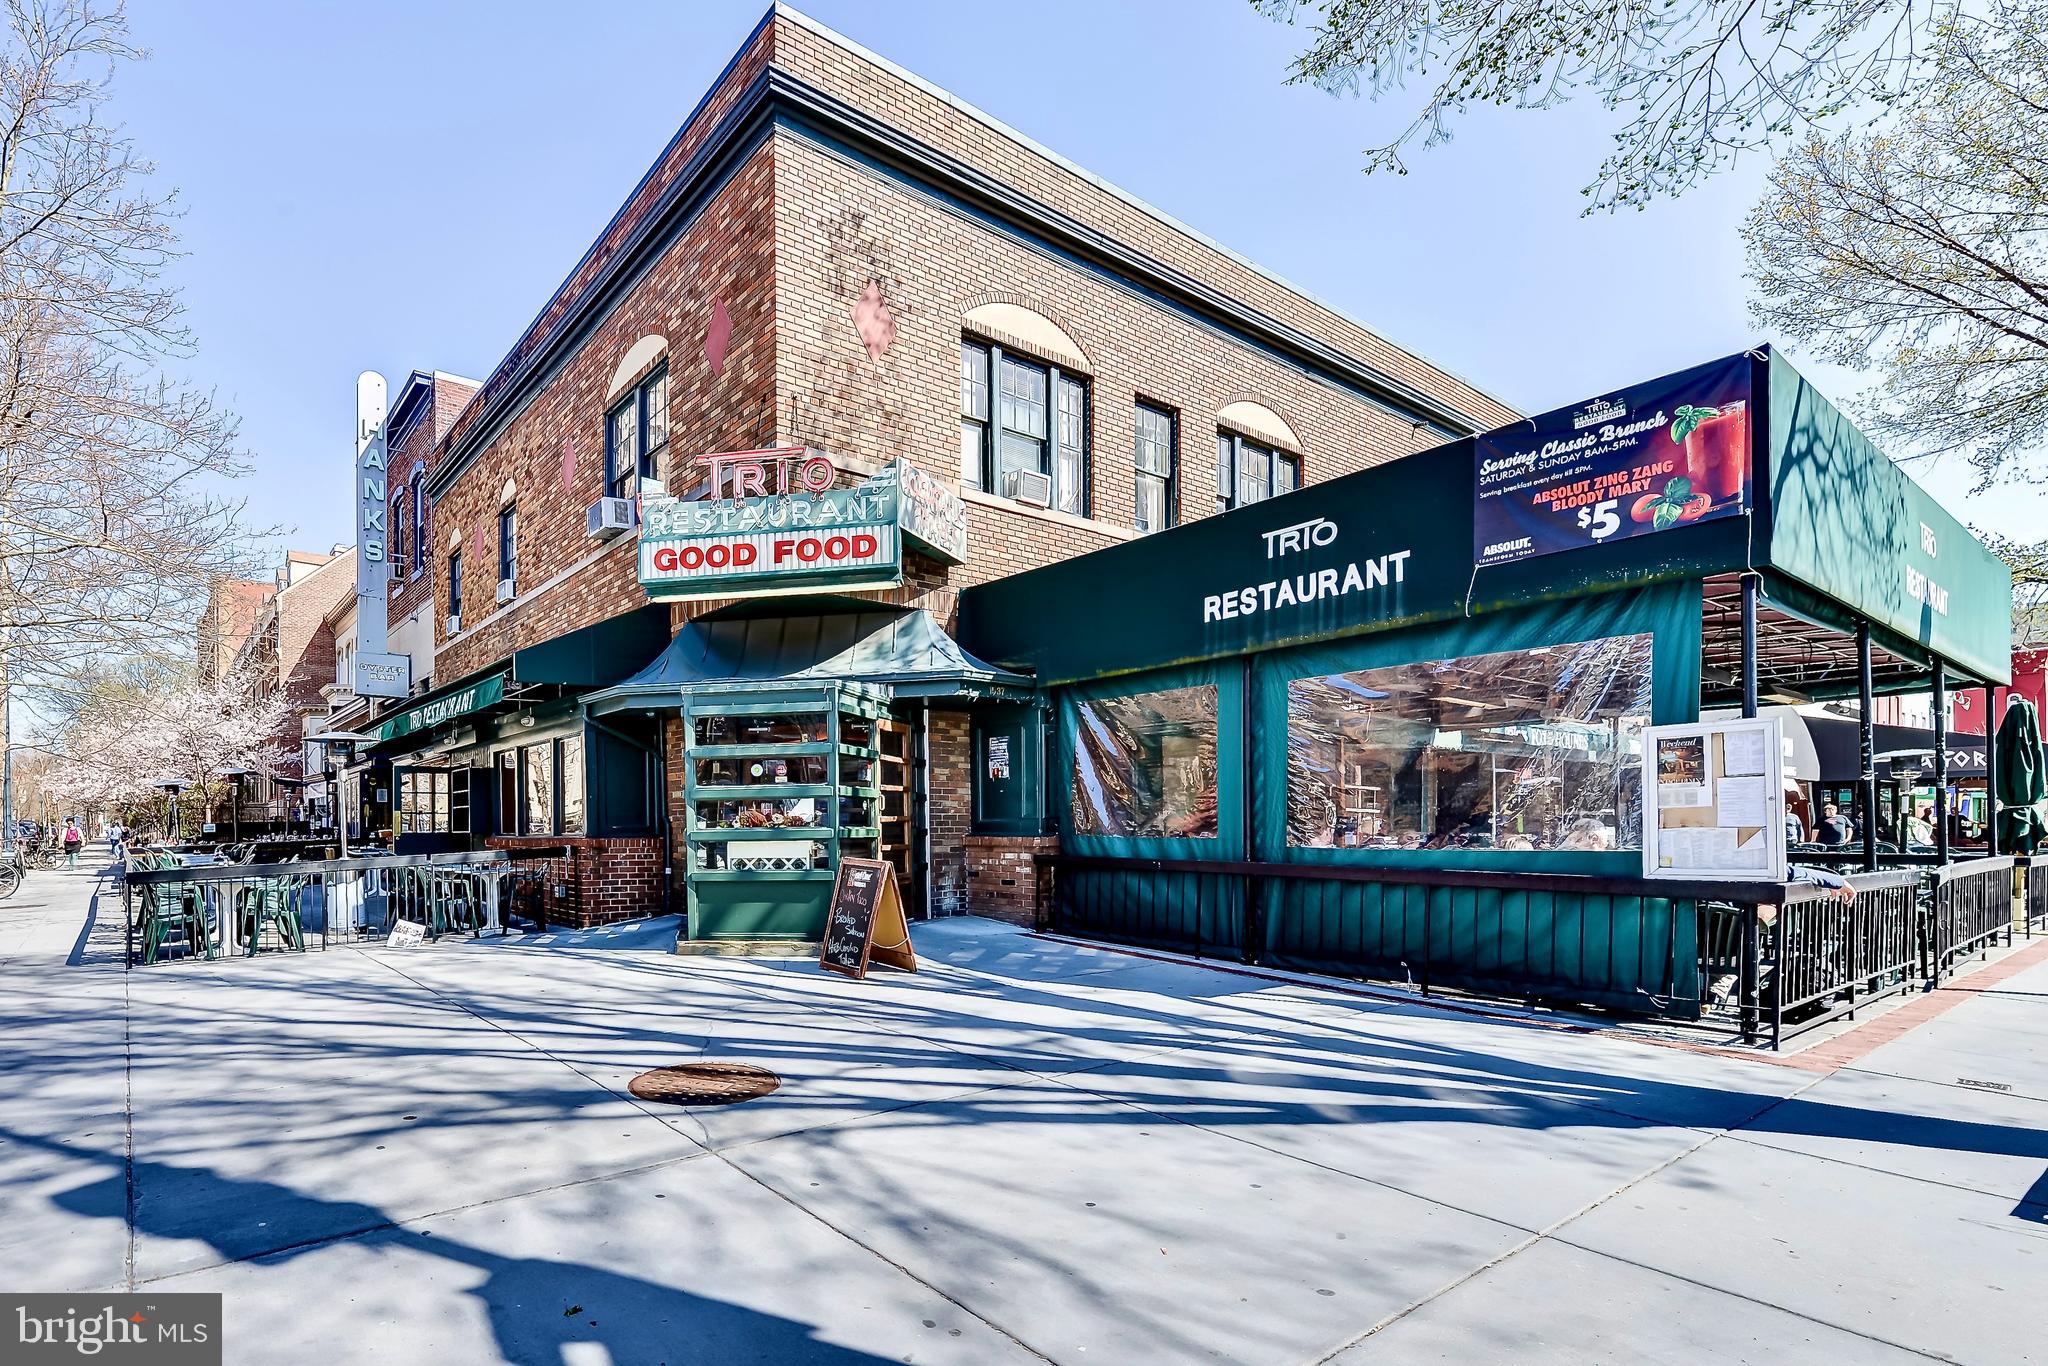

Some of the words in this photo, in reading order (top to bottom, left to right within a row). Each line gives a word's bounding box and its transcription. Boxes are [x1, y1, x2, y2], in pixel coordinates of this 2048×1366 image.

[1574, 403, 1626, 423] RESTAURANT
[1577, 417, 1599, 427] GOOD
[1584, 400, 1611, 413] TRIO
[1479, 450, 1538, 475] Serving
[1541, 431, 1597, 459] Classic
[1599, 410, 1668, 442] Brunch
[1479, 465, 1527, 486] SATURDAY
[1528, 464, 1536, 472] &
[1538, 451, 1582, 470] SUNDAY
[1584, 437, 1639, 458] 8AM-5PM.
[361, 419, 386, 562] HANKS
[694, 446, 836, 501] TRIO
[1479, 490, 1502, 499] Serving
[1503, 481, 1533, 493] breakfast
[1533, 476, 1550, 486] every
[1550, 472, 1564, 480] day
[1574, 464, 1593, 474] 5PM.
[1532, 479, 1591, 505] ABSOLUT
[1593, 471, 1629, 489] ZING
[1632, 460, 1674, 480] ZANG
[1551, 489, 1604, 512] BLOODY
[1608, 478, 1652, 498] MARY
[649, 494, 889, 537] RESTAURANT
[1576, 499, 1621, 539] $5
[654, 543, 758, 572] GOOD
[774, 534, 878, 564] FOOD
[1262, 517, 1338, 559] TRIO
[1479, 553, 1514, 564] TRANSFORM
[1515, 548, 1536, 556] TODAY
[1919, 521, 1937, 560] TRIO
[1204, 550, 1411, 623] RESTAURANT
[1906, 564, 1949, 617] RESTAURANT
[359, 663, 405, 674] OYSTER
[370, 673, 395, 681] BAR
[409, 710, 422, 730] TRIO
[423, 689, 476, 724] RESTAURANT
[1660, 738, 1697, 748] Weekend
